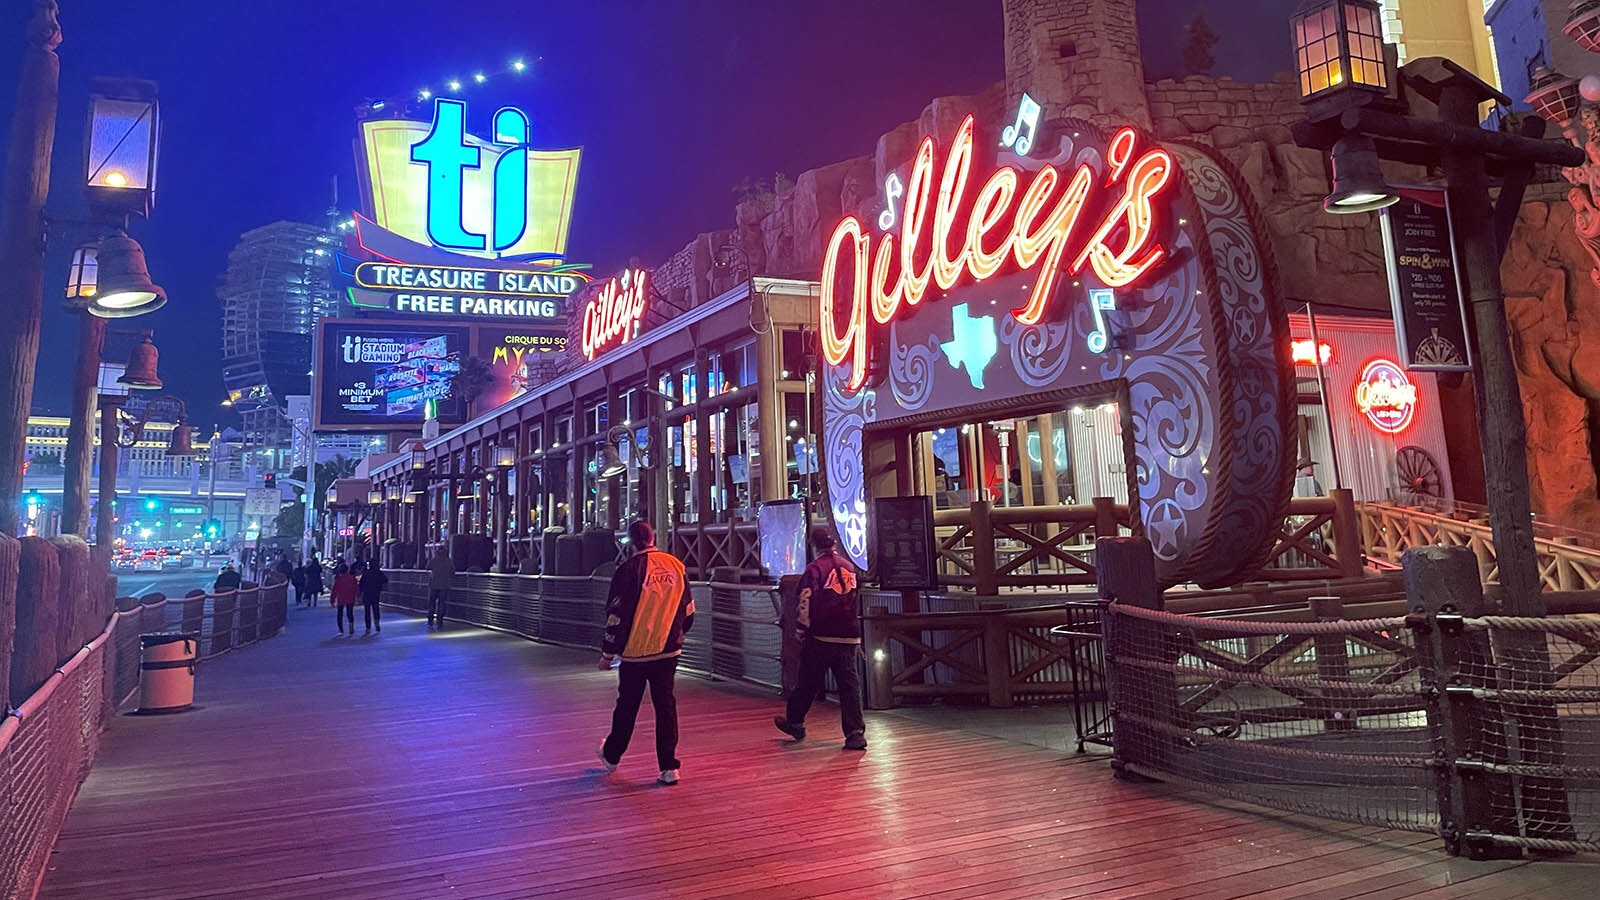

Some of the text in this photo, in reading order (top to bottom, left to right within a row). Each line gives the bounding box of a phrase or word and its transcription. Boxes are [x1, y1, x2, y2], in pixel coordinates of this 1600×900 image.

[409, 98, 530, 252] ti
[372, 266, 576, 294] TREASURE ISLAND
[397, 294, 555, 318] FREE PARKING
[505, 335, 539, 345] CIRQUE
[539, 336, 553, 345] DU
[342, 335, 361, 363] ti
[362, 343, 405, 354] STADIUM
[362, 353, 400, 362] GAMING
[339, 388, 384, 396] MINIMUM
[350, 395, 373, 403] BET
